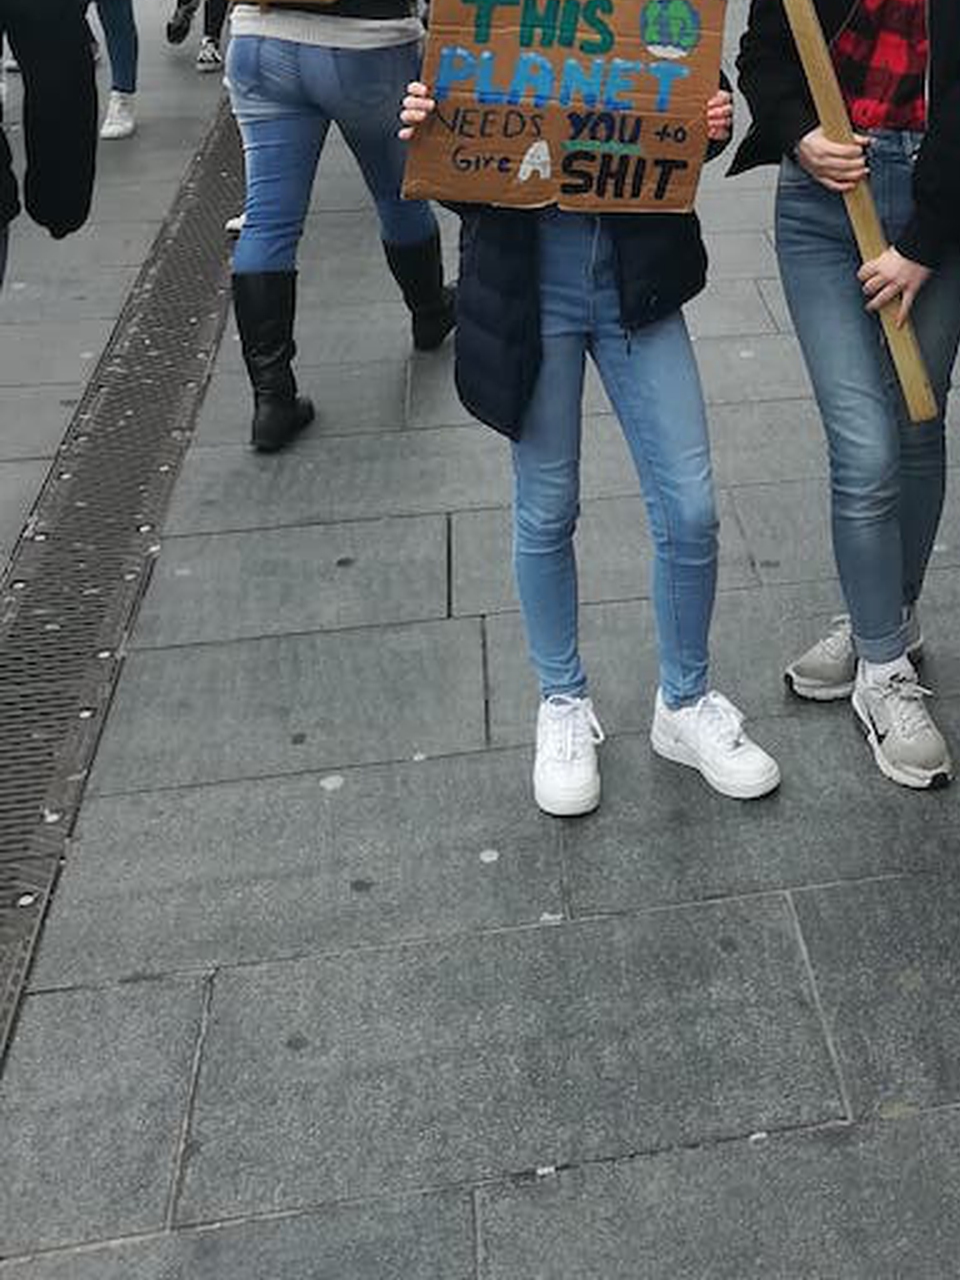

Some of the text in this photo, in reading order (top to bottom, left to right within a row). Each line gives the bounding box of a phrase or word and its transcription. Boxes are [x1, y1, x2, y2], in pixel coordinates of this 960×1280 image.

[433, 44, 692, 114] PLANET
[434, 106, 687, 146] NEEDS YOU to
[517, 139, 552, 184] A
[559, 151, 690, 201] SHIT
